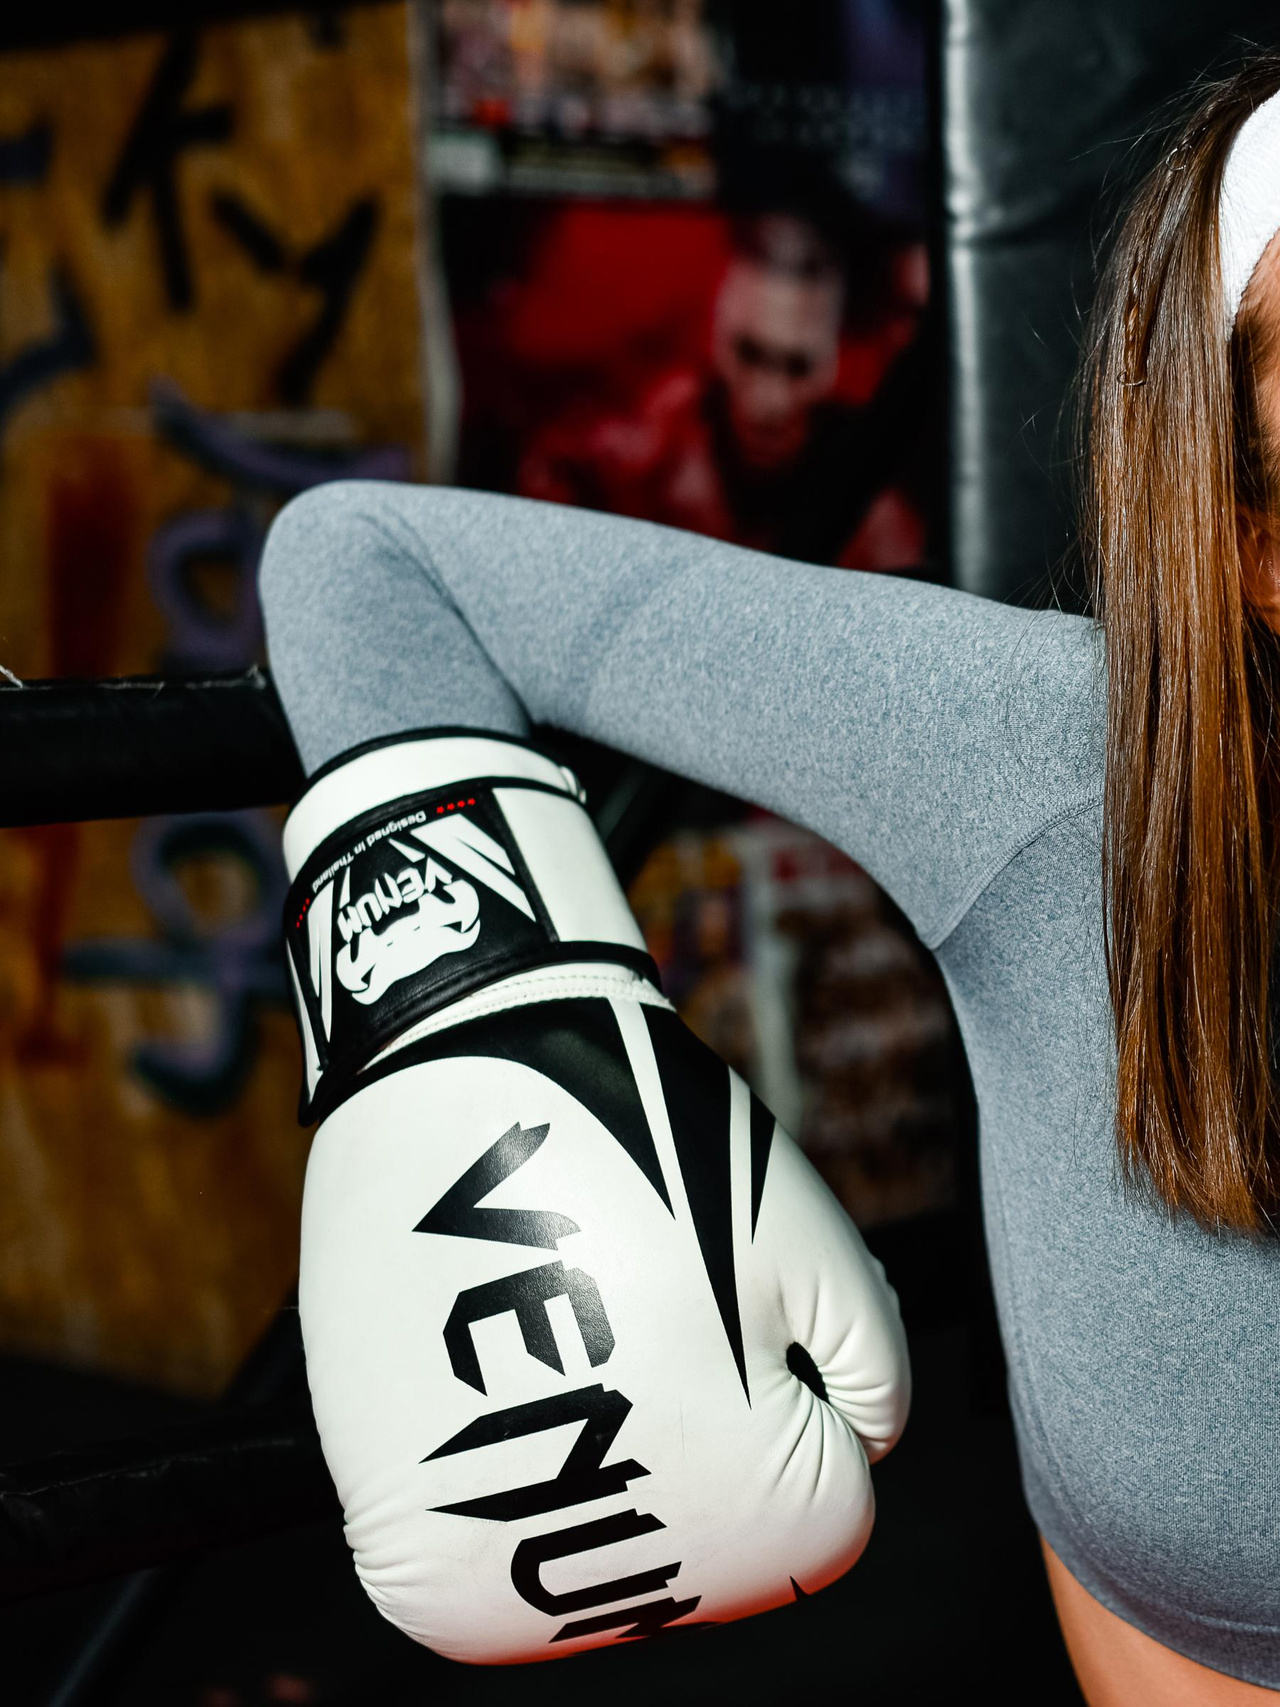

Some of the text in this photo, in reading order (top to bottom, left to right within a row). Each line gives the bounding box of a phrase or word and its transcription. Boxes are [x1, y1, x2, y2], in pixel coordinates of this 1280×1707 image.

[365, 809, 427, 848] Designed
[311, 851, 355, 894] Thailand
[337, 856, 453, 943] VENUM
